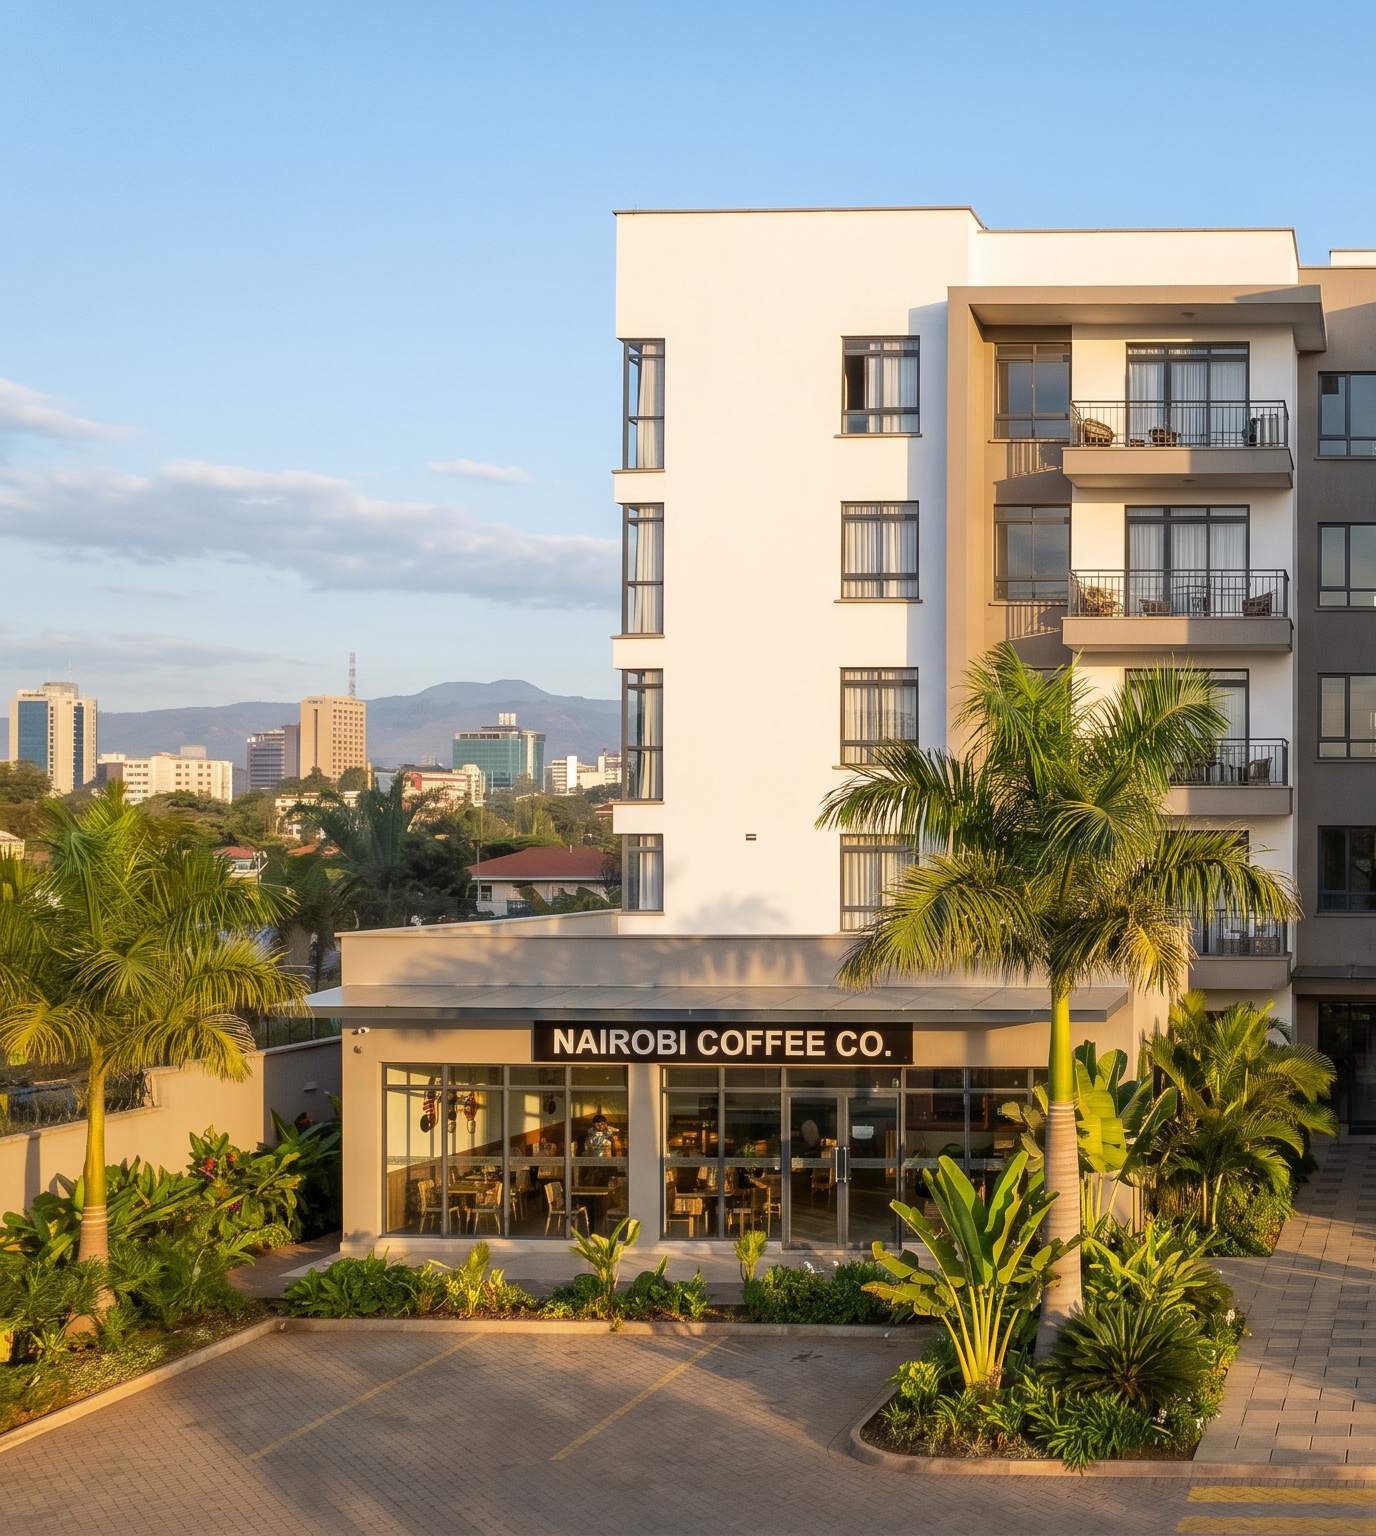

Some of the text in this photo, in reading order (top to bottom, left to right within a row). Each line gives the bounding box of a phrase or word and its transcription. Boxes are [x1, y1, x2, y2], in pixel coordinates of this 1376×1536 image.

[553, 1029, 892, 1057] NAIROBI COFFEE CO.
